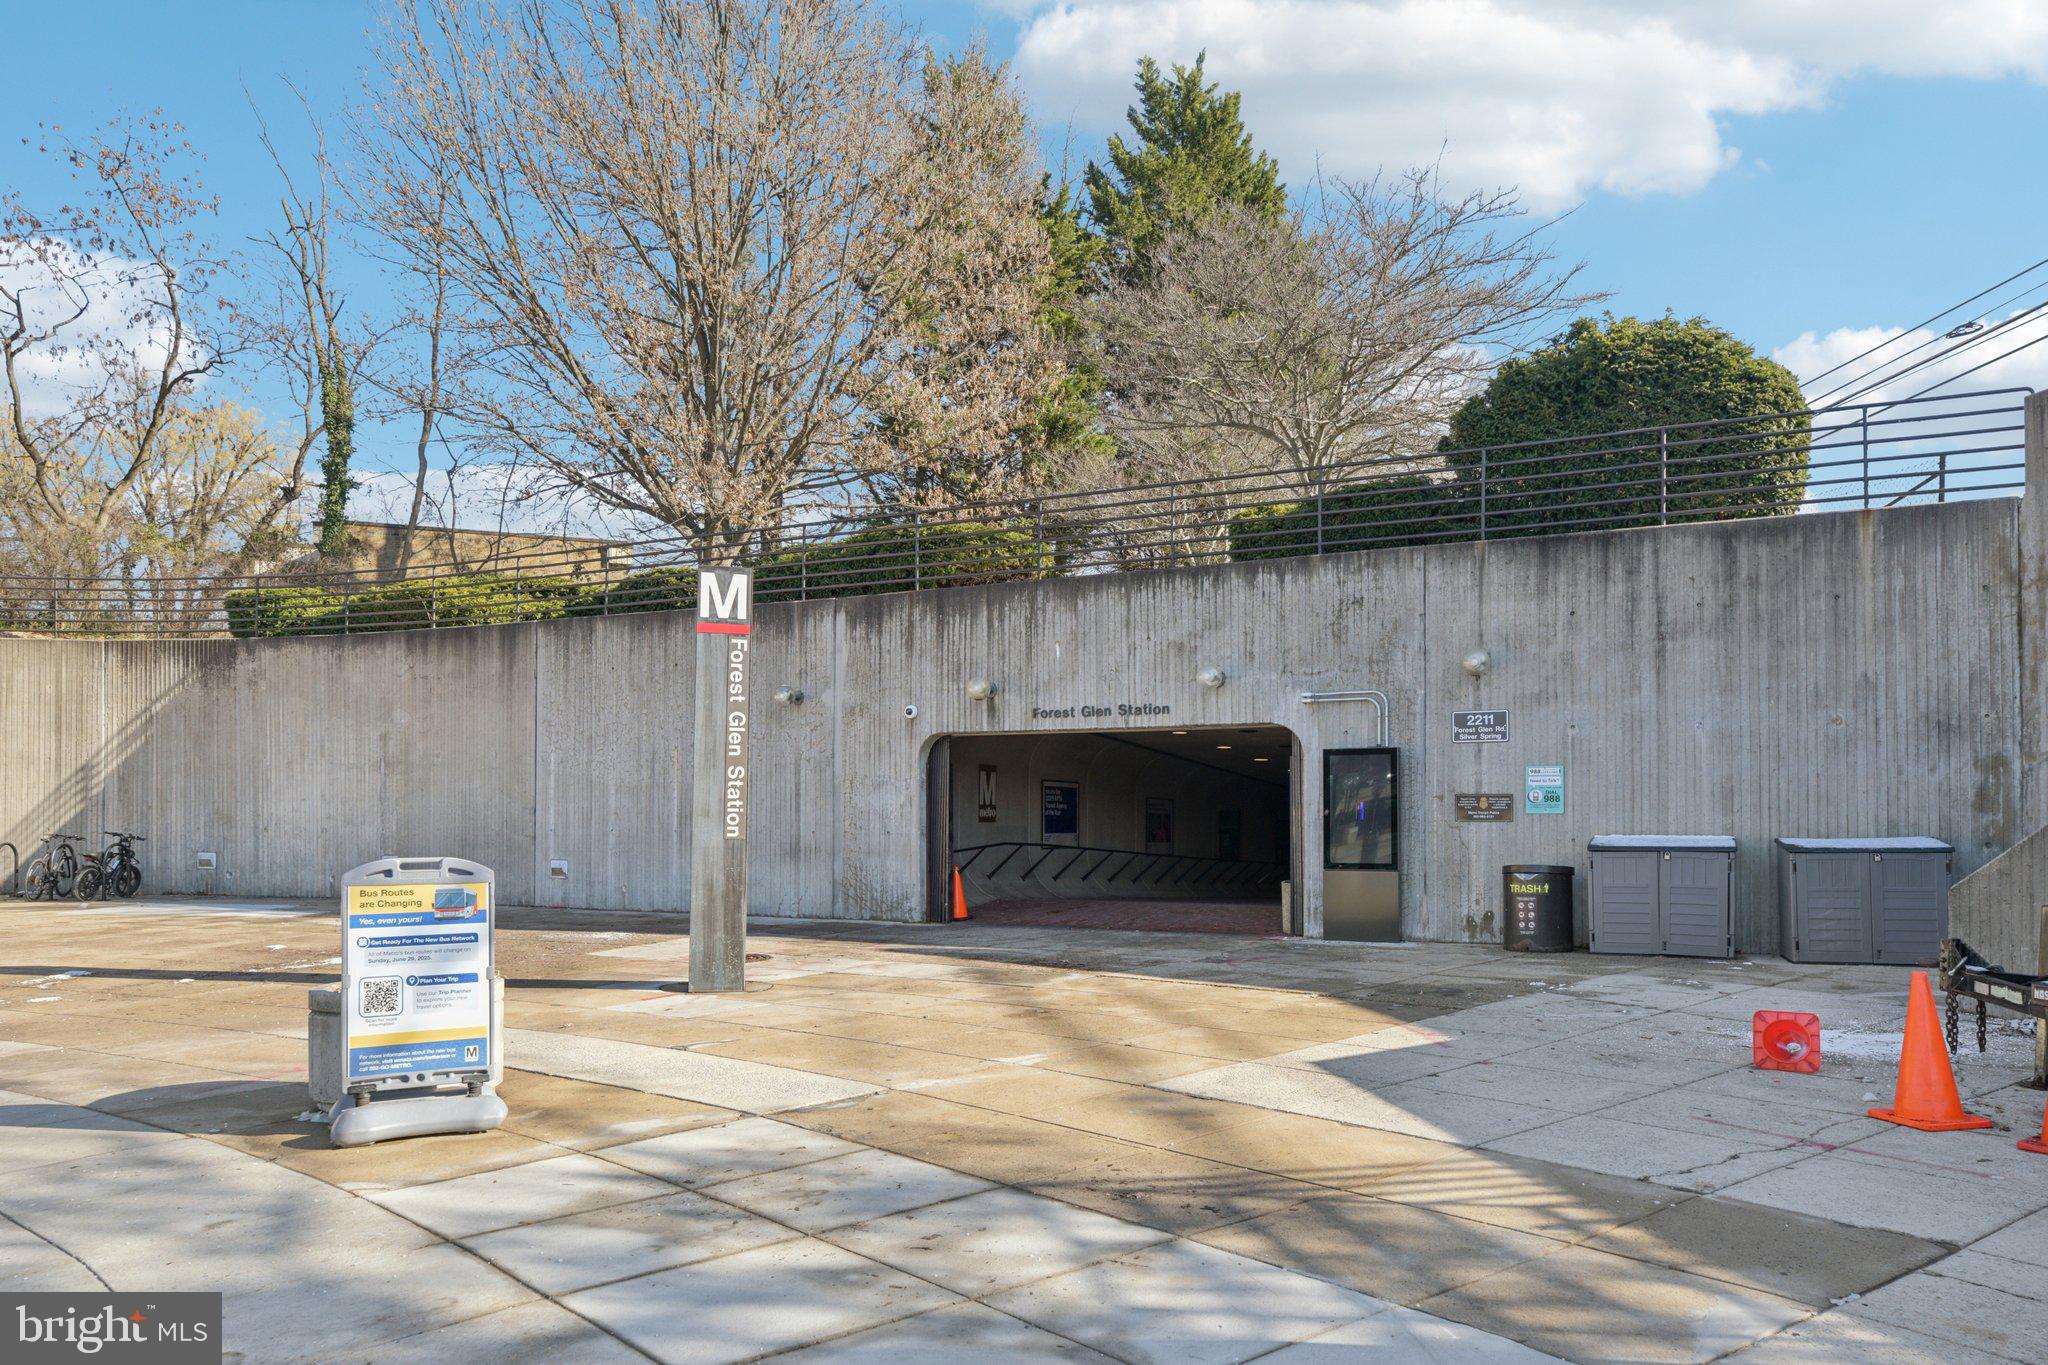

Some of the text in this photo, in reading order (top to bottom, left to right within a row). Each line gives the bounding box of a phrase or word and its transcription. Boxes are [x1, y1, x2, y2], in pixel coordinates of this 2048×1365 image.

[700, 572, 748, 619] M
[1033, 703, 1170, 719] Forest Glen Station
[1466, 714, 1494, 726] 2211
[726, 638, 748, 838] Forest Glen Station
[1480, 733, 1502, 741] Spring
[980, 770, 996, 805] M
[1543, 794, 1560, 803] 988
[360, 888, 414, 898] Bus Routes
[1510, 884, 1541, 893] TRASH
[377, 898, 422, 908] Changing
[359, 917, 375, 925] Yes,
[398, 916, 423, 925] yours!
[466, 1046, 477, 1057] M
